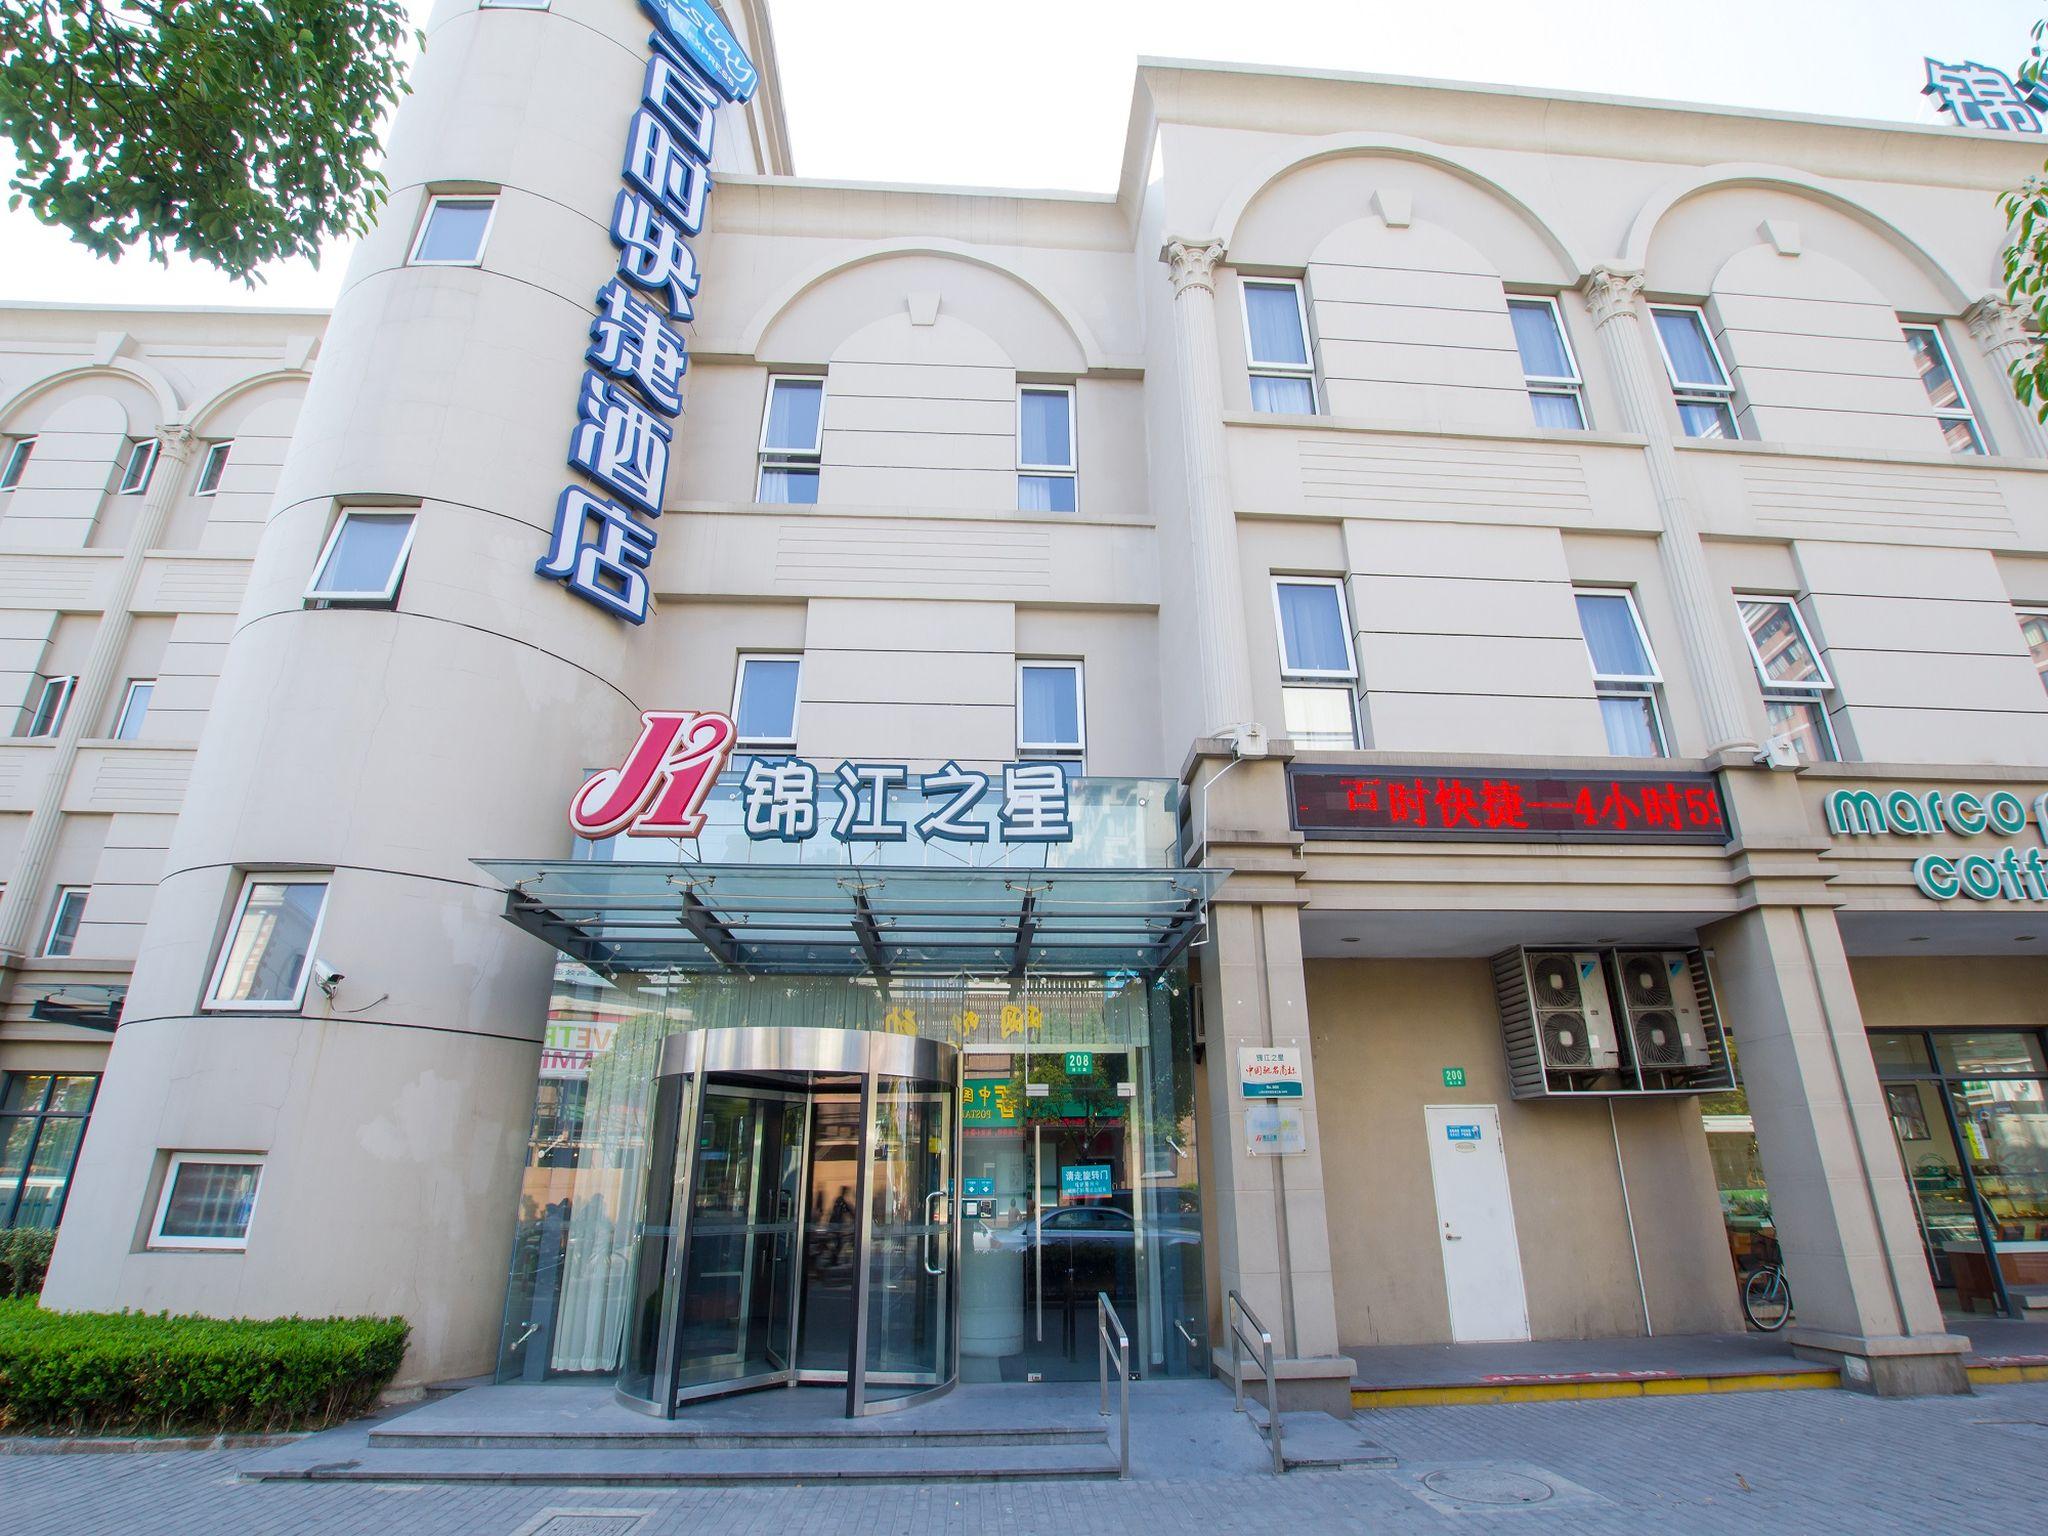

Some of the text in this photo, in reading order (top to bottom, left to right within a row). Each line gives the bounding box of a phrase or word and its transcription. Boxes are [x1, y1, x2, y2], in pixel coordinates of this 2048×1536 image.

[536, 31, 720, 625] 百时快捷酒店
[743, 757, 1073, 842] 锦江之星
[1825, 788, 2027, 837] marco
[1069, 1054, 1089, 1067] 208
[1445, 1070, 1463, 1081] 200
[1065, 1169, 1109, 1182] 请走旋转门
